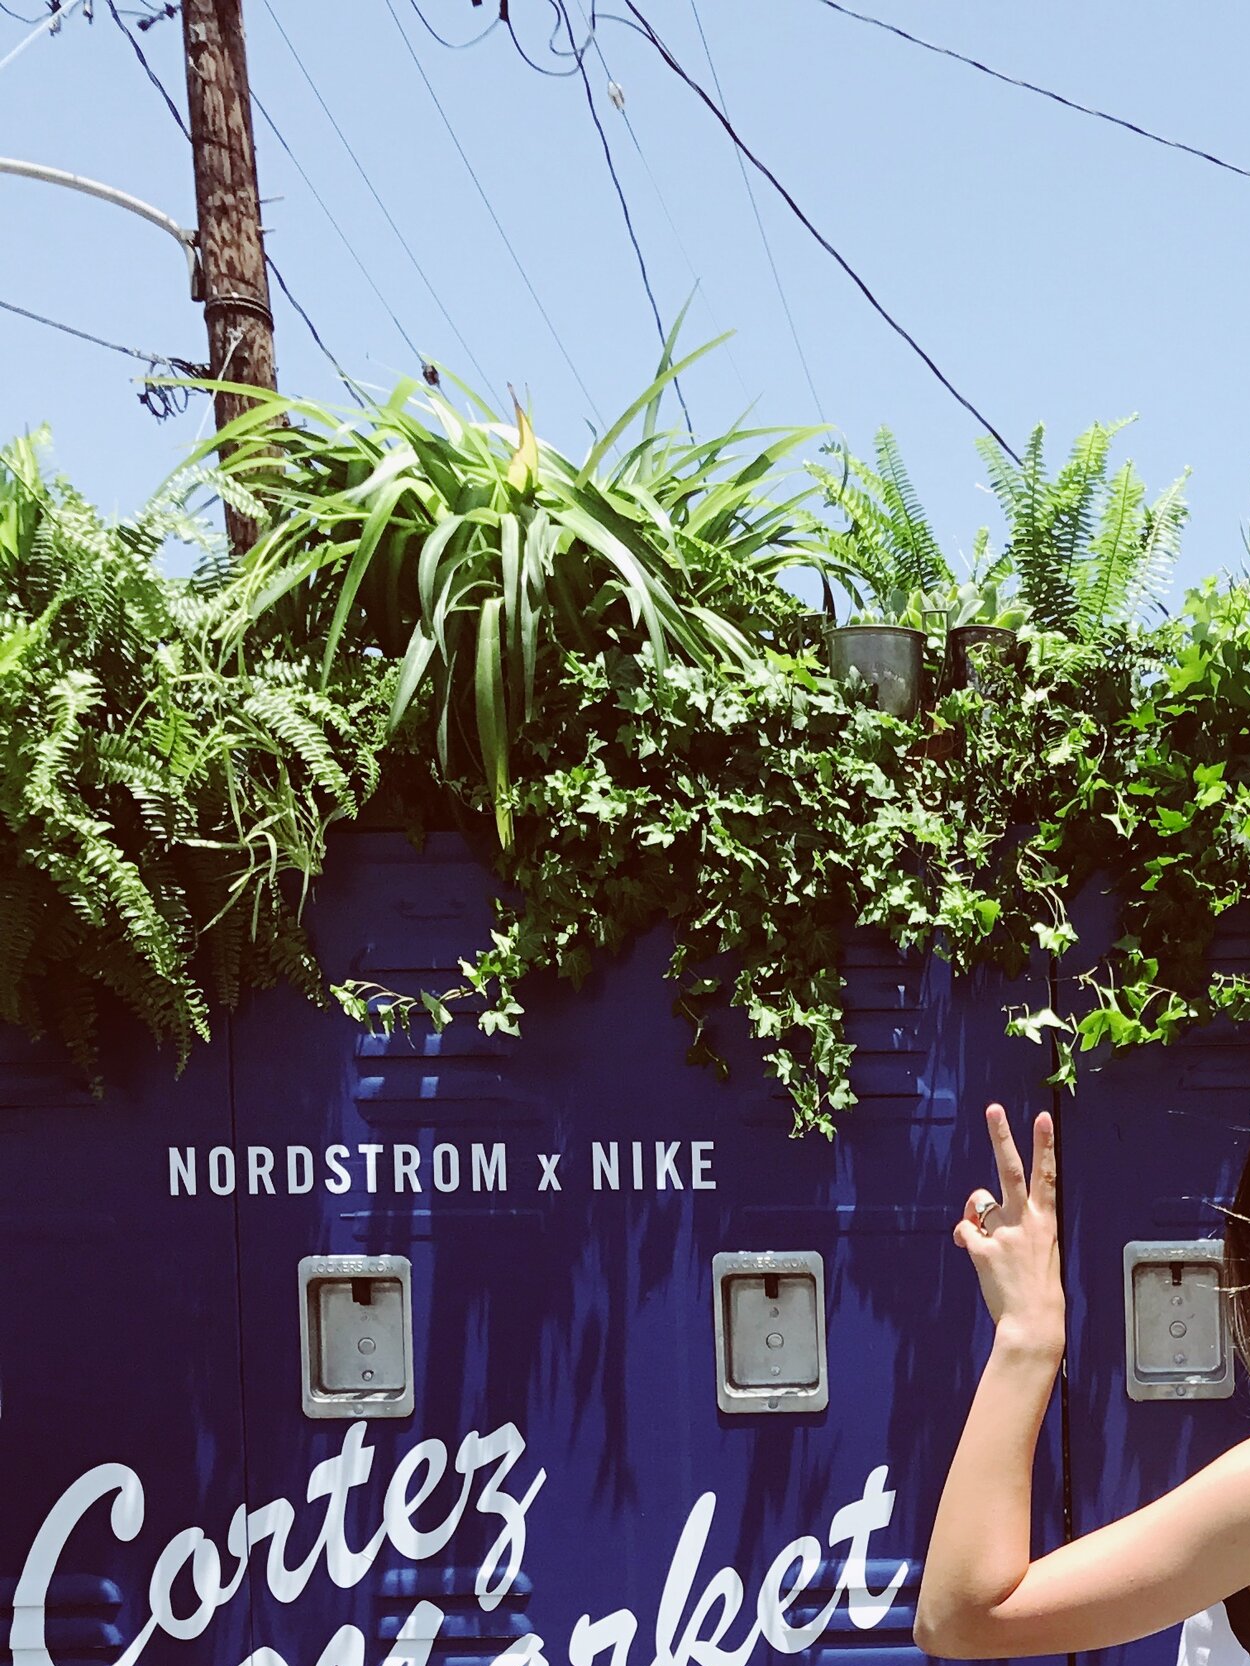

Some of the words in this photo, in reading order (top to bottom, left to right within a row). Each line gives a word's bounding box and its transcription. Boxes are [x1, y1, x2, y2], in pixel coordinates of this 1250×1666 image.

[168, 1142, 509, 1197] NORDSTROM
[537, 1153, 562, 1192] x
[592, 1140, 719, 1191] NIKE
